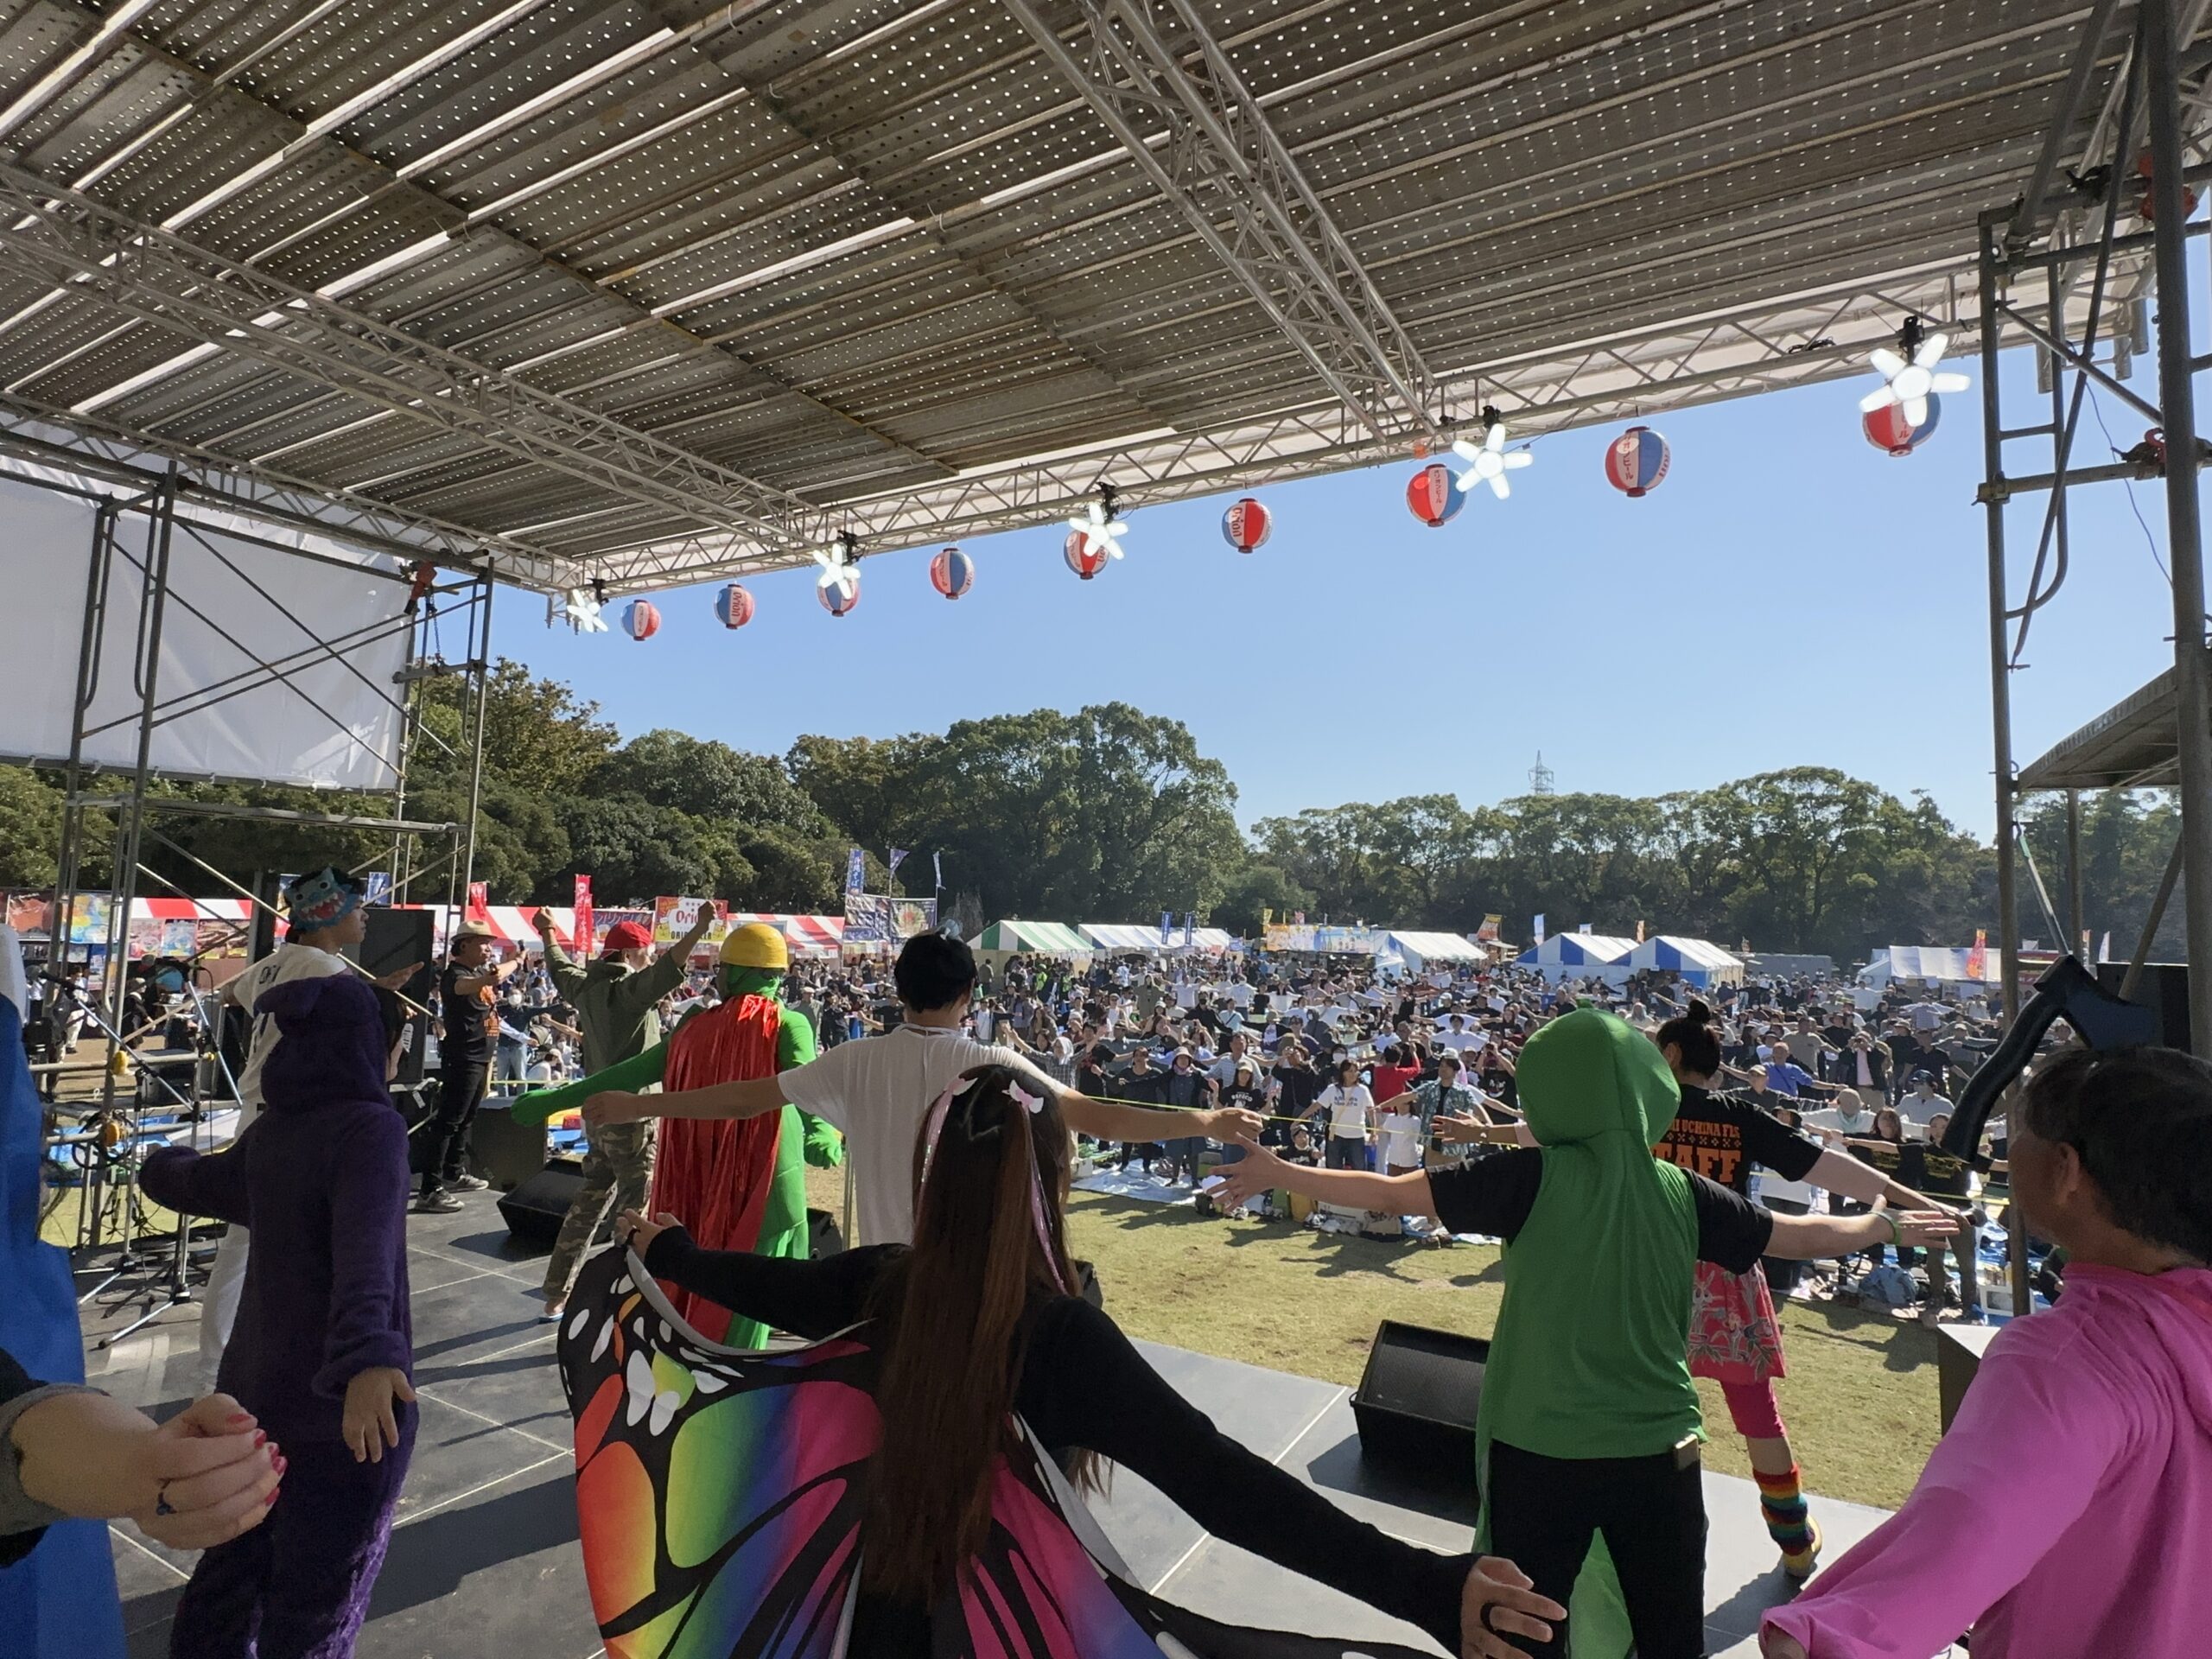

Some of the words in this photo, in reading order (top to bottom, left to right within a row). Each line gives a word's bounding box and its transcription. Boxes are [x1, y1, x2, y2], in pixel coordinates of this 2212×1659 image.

[1231, 507, 1244, 537] Orion
[732, 592, 743, 617] Orion
[676, 910, 700, 925] Ori
[1681, 1119, 1721, 1137] UCHINA
[1652, 1141, 1741, 1183] TAFF
